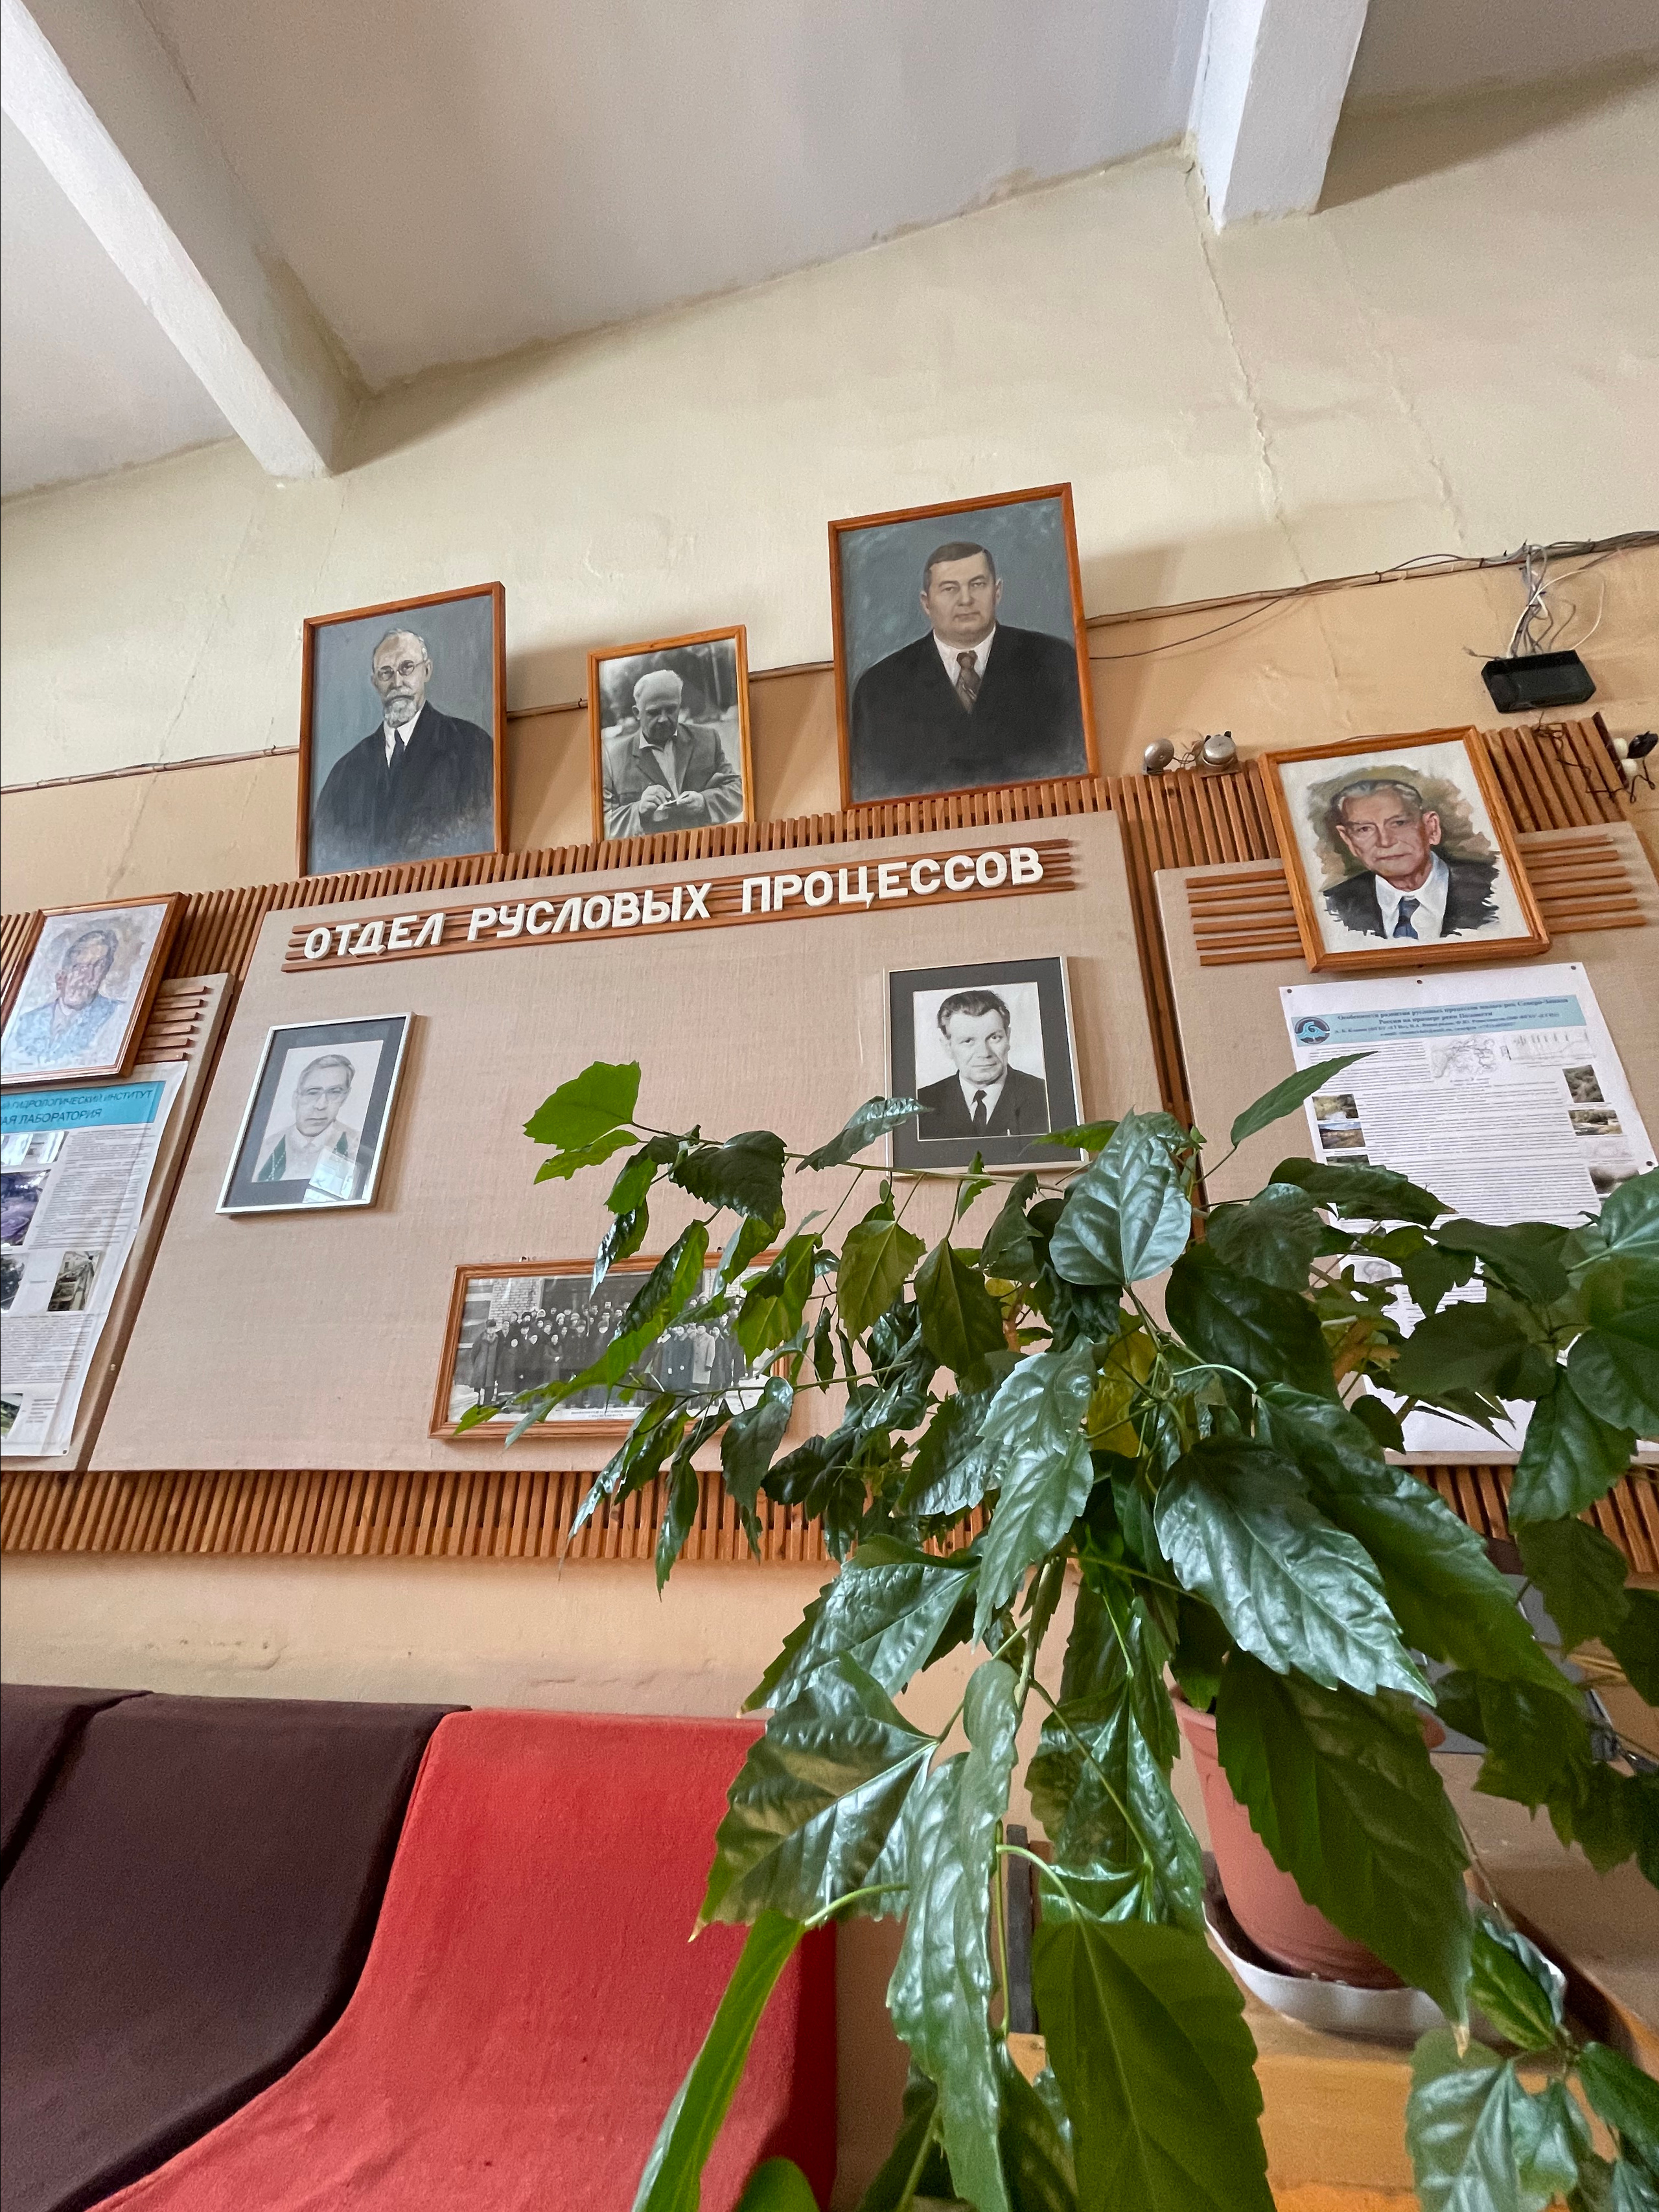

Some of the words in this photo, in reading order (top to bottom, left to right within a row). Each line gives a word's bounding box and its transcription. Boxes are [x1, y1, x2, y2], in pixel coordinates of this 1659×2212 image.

[304, 913, 446, 960] ОТДЕЛ
[467, 883, 712, 942] РУСЛОВЫХ
[742, 848, 1043, 913] ПРОЦЕССОВ
[12, 1093, 102, 1109] ГИДРОЛОГИЧЕСКИЙ
[104, 1089, 153, 1101] ИНСТИТУТ
[1, 1115, 17, 1125] АЯ
[19, 1108, 102, 1124] ЛАБОРАТОРИЯ
